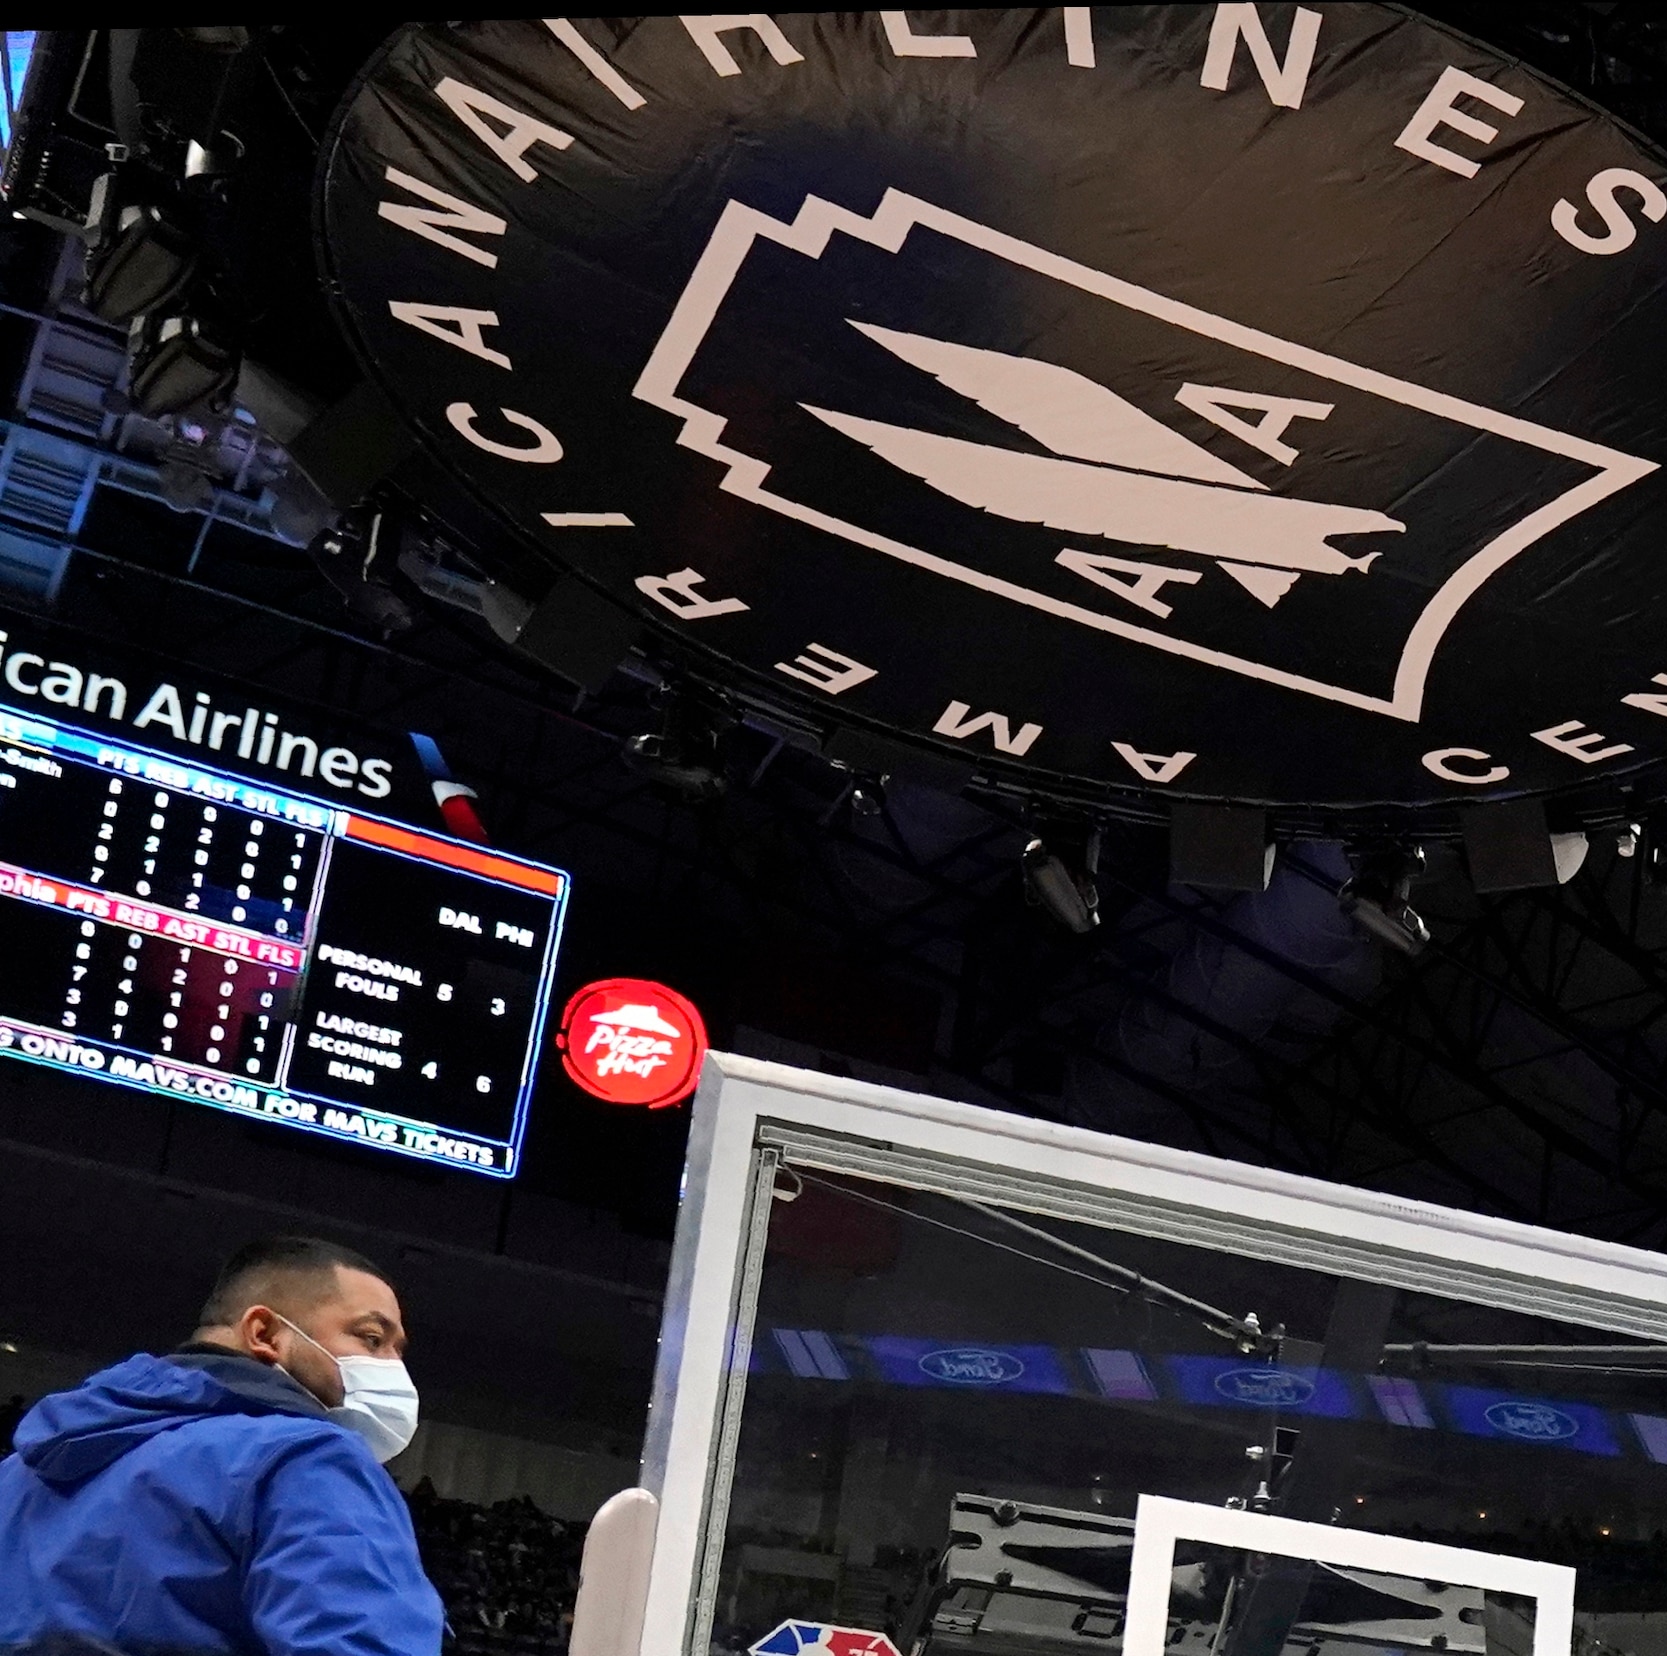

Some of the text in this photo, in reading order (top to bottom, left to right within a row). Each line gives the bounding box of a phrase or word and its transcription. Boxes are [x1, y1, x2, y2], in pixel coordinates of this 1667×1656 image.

[378, 168, 1197, 783] AMERICAN
[133, 684, 394, 801] Airlines
[97, 747, 140, 774] PTS
[192, 777, 240, 802] AST
[242, 791, 281, 815] STL
[97, 822, 114, 840] 2
[144, 835, 161, 853] 2
[197, 827, 213, 845] 2
[290, 854, 302, 870] 1
[294, 832, 306, 849] 1
[90, 866, 105, 884] 7
[184, 892, 201, 910] 2
[143, 859, 156, 875] 1
[191, 872, 204, 888] 1
[281, 897, 294, 913] 1
[66, 891, 295, 967] PTS REB AST STL FLS
[439, 908, 534, 947] DAL PHI
[172, 968, 188, 986] 2
[179, 947, 191, 963] 1
[267, 970, 278, 986] 1
[318, 945, 423, 986] PERSONAL
[72, 965, 270, 1031] 7 4 1 1 1
[335, 973, 506, 1016] FOULS 5 3
[61, 1010, 77, 1028] 3
[111, 1023, 123, 1040] 1
[160, 1035, 173, 1052] 1
[65, 988, 82, 1005] 3
[253, 1036, 266, 1053] 1
[316, 1011, 403, 1046] LARGEST
[585, 1027, 673, 1057] Pizza
[307, 1034, 402, 1070] SCORING
[421, 1062, 438, 1080] 4
[327, 1061, 375, 1085] RUN
[596, 1056, 667, 1080] Hut
[20, 1034, 105, 1070] ONTO
[110, 1056, 259, 1108] MAVS.COM
[264, 1095, 318, 1124] FOR
[323, 1109, 398, 1144] MAVS
[403, 1128, 494, 1167] TICKETS
